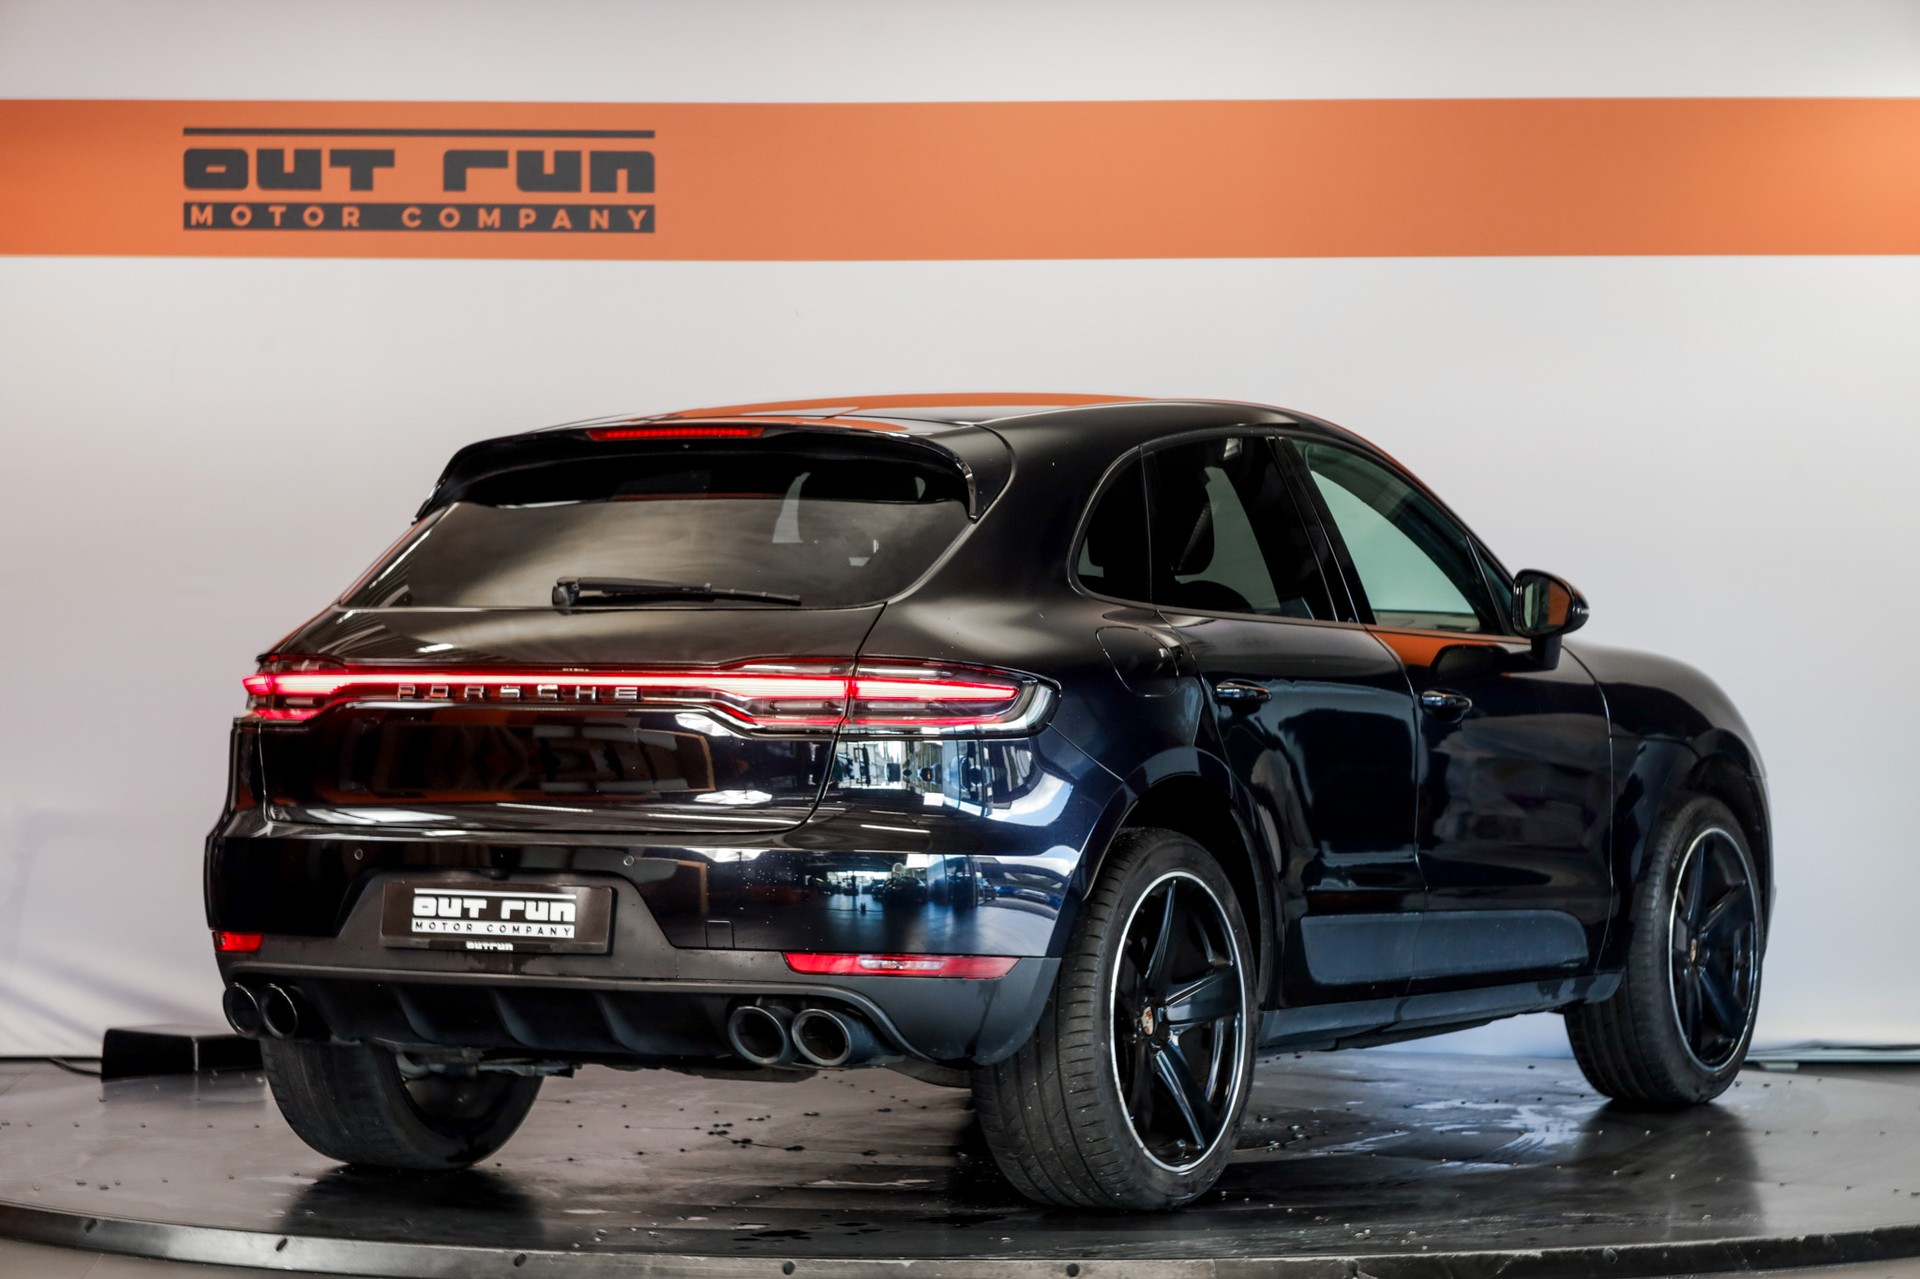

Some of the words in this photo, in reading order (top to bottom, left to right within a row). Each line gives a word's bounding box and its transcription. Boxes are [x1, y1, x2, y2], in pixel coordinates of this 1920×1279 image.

[191, 205, 360, 227] MOTOR
[402, 208, 648, 230] COMPANY
[398, 684, 639, 701] PORSCHE
[415, 921, 473, 932] MOTOR
[487, 924, 571, 936] COMPANY
